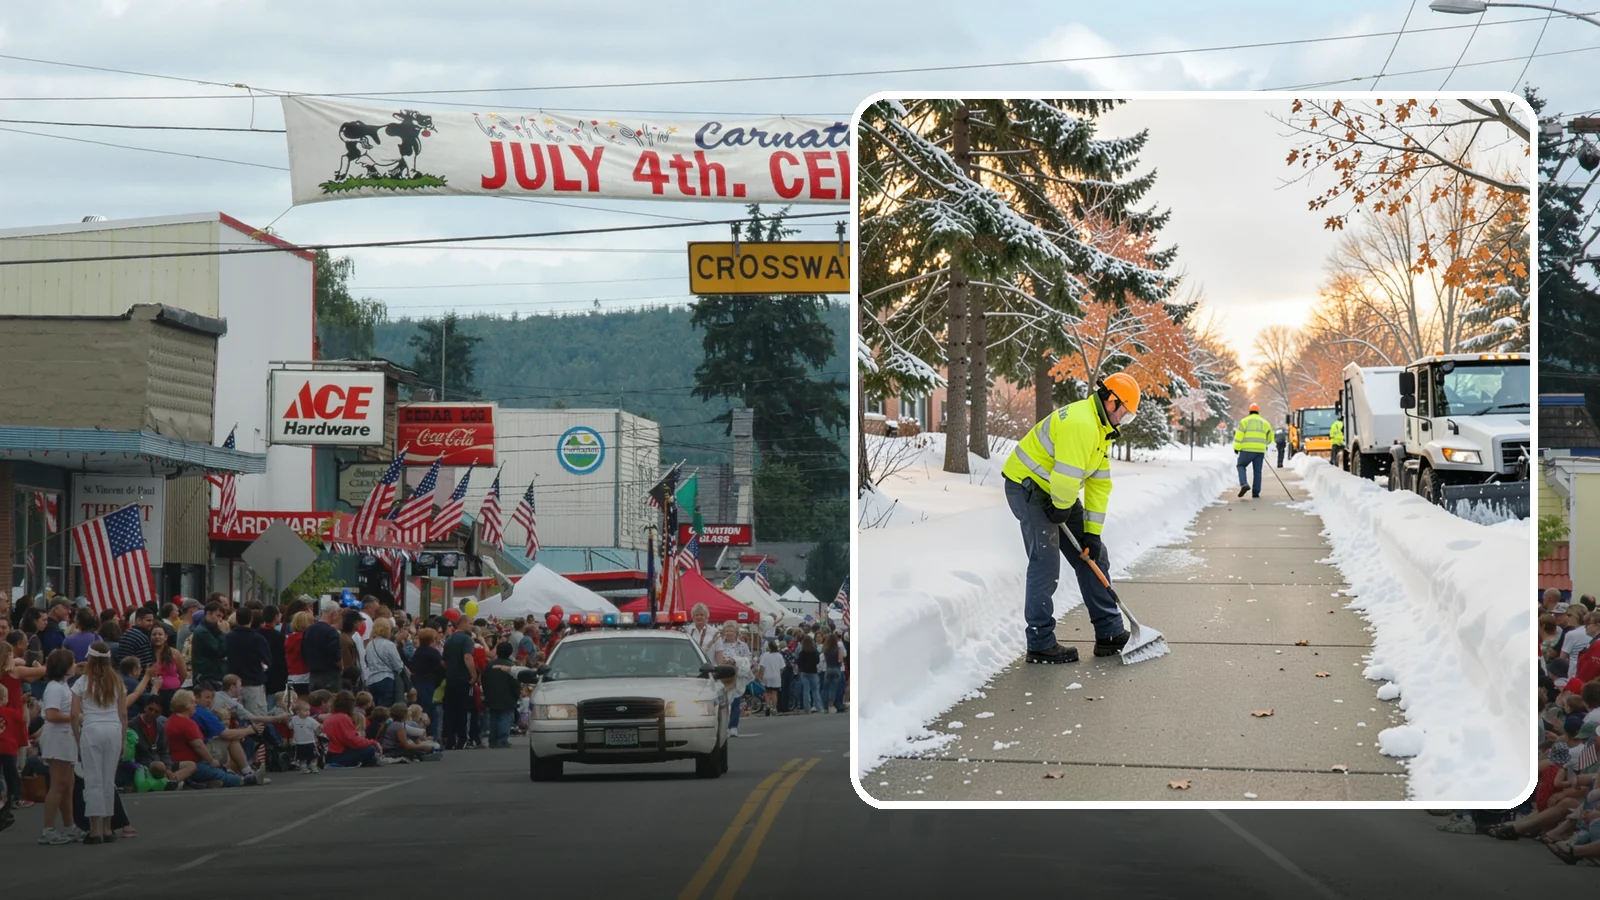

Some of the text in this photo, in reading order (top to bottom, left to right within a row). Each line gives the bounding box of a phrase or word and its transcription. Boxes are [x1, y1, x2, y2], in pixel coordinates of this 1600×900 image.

[695, 121, 850, 149] Carnat
[481, 141, 605, 192] JULY
[632, 150, 747, 197] 4th.
[696, 254, 850, 280] CROSSWA
[282, 380, 374, 420] ACE
[405, 409, 485, 422] CEDAR LOG
[283, 421, 371, 436] Hardware
[353, 467, 387, 480] Simpl
[95, 486, 124, 494] Vincent
[126, 486, 136, 494] de
[138, 486, 155, 495] Paul
[212, 516, 331, 535] HARDARE
[688, 526, 741, 535] CRNATION
[699, 535, 730, 543] GLASS
